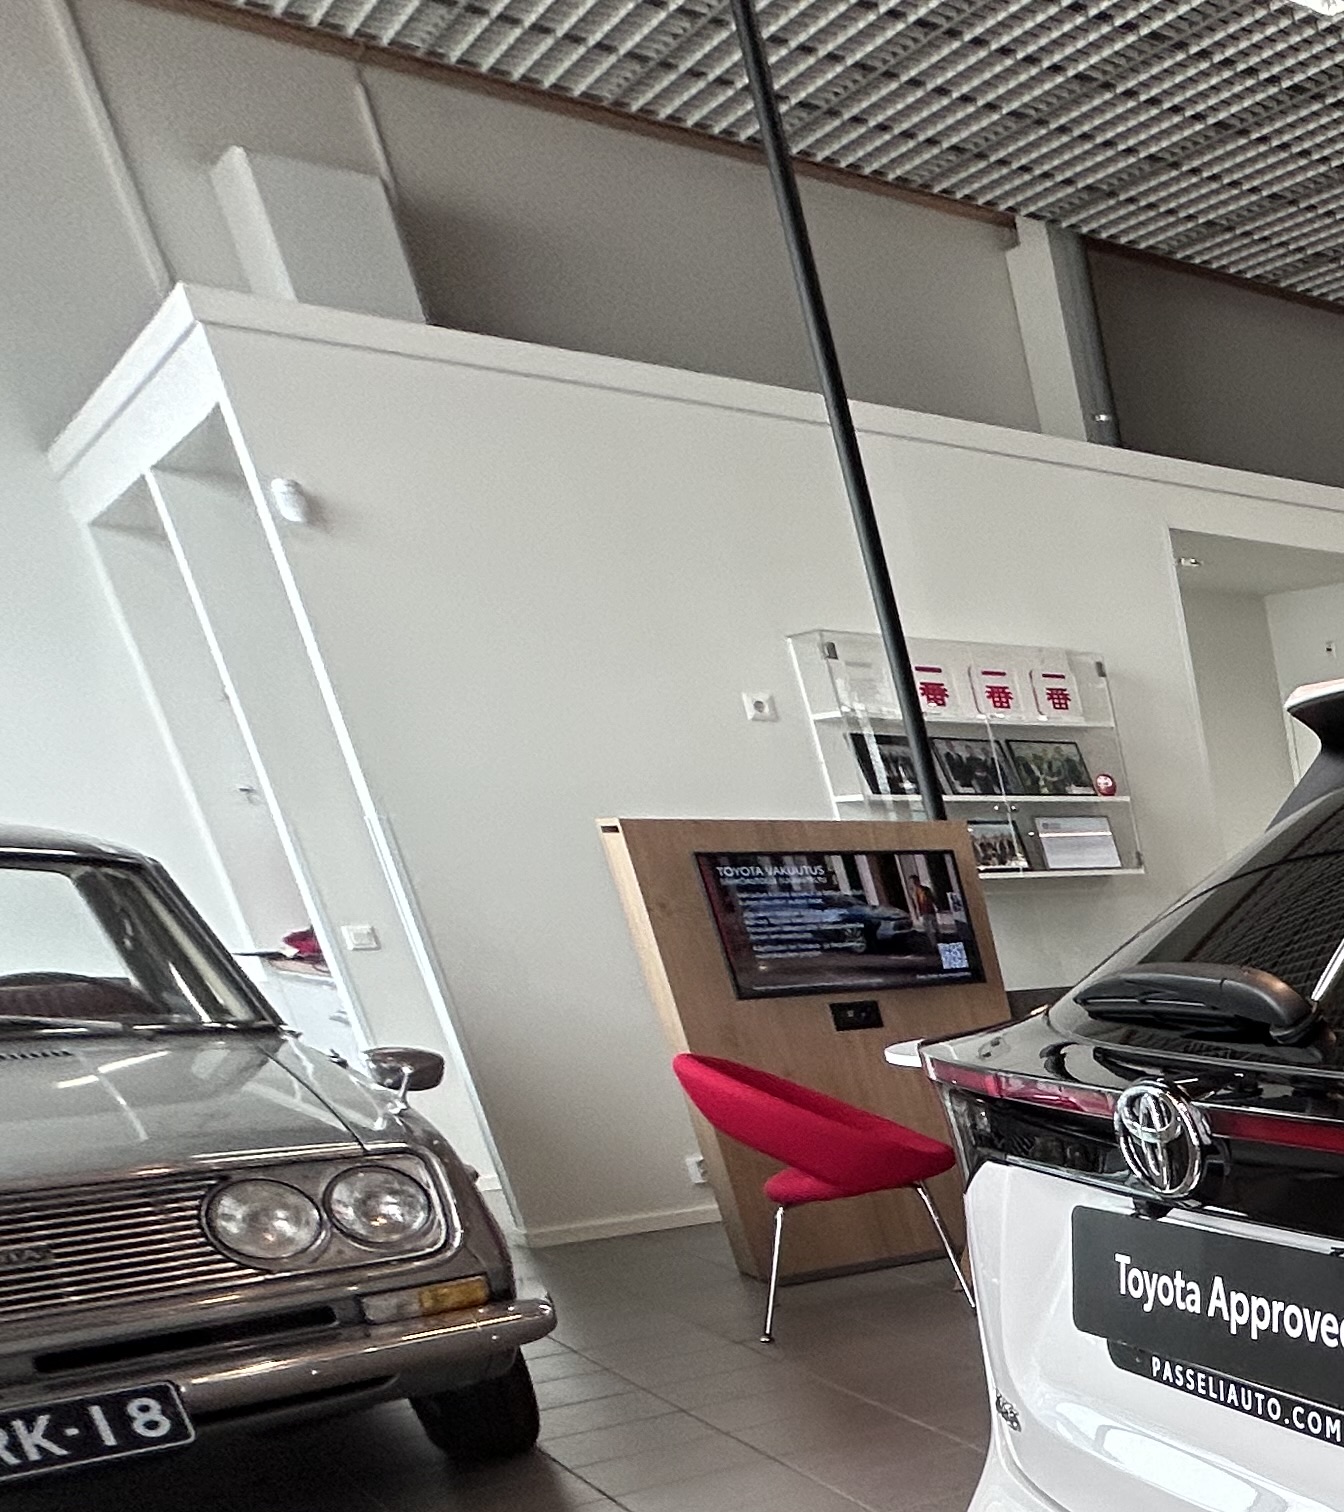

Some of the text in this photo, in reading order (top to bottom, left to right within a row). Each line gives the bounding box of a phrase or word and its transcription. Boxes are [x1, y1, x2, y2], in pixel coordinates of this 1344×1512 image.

[981, 670, 1014, 709] 一番
[1042, 673, 1072, 711] 一番
[716, 865, 825, 877] TOYOTA VAKUUTUS
[1114, 1253, 1201, 1313] Toyota
[1151, 1356, 1342, 1443] PASSELIAUTO.COM
